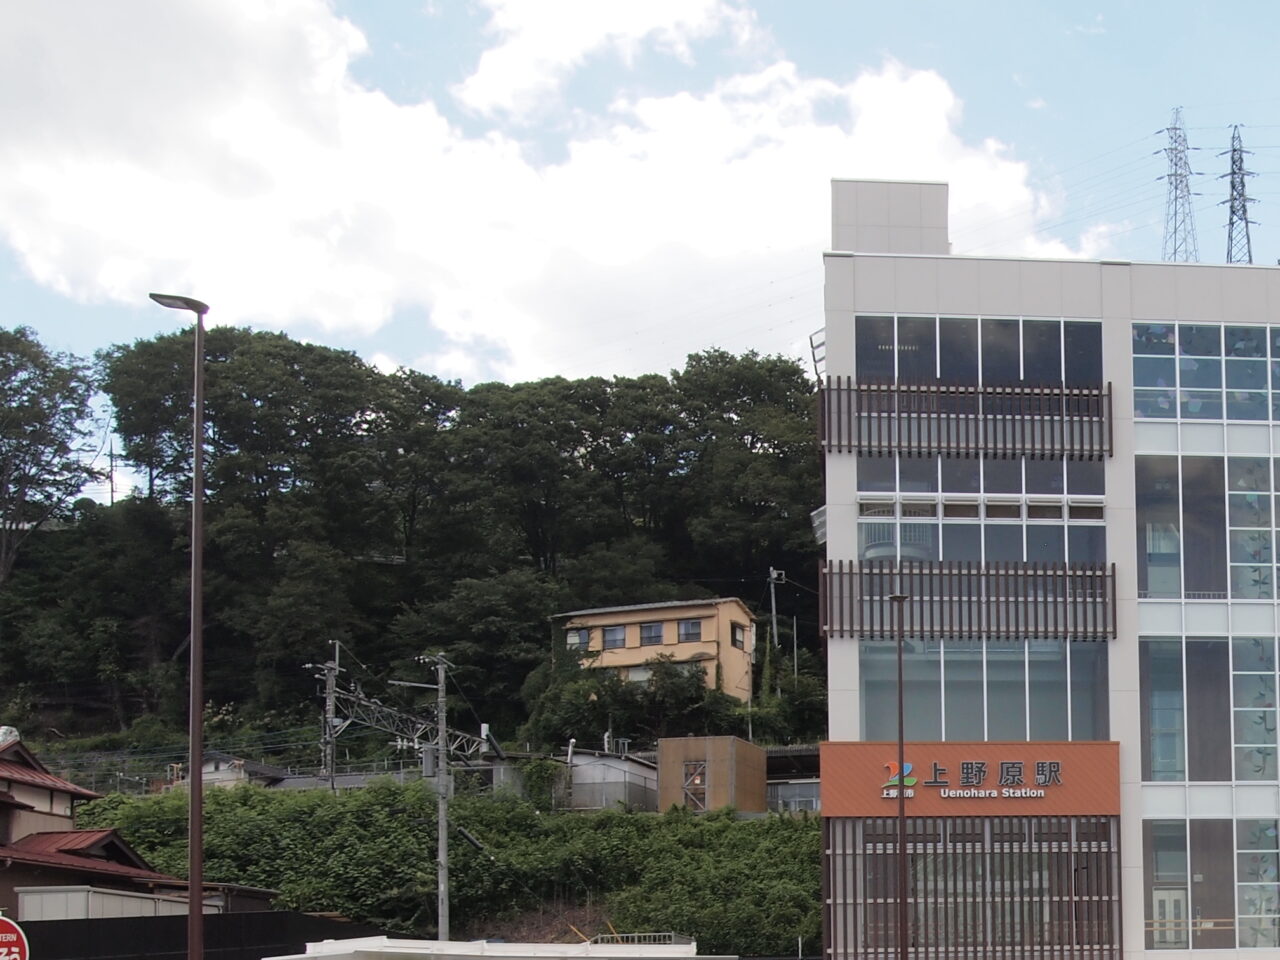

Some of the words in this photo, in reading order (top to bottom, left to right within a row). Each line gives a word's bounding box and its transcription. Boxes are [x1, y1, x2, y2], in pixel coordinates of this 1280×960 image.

[923, 760, 1062, 787] 上野原駅
[881, 789, 914, 798] 上野市
[940, 787, 998, 799] Uenohara
[1001, 787, 1045, 799] Station
